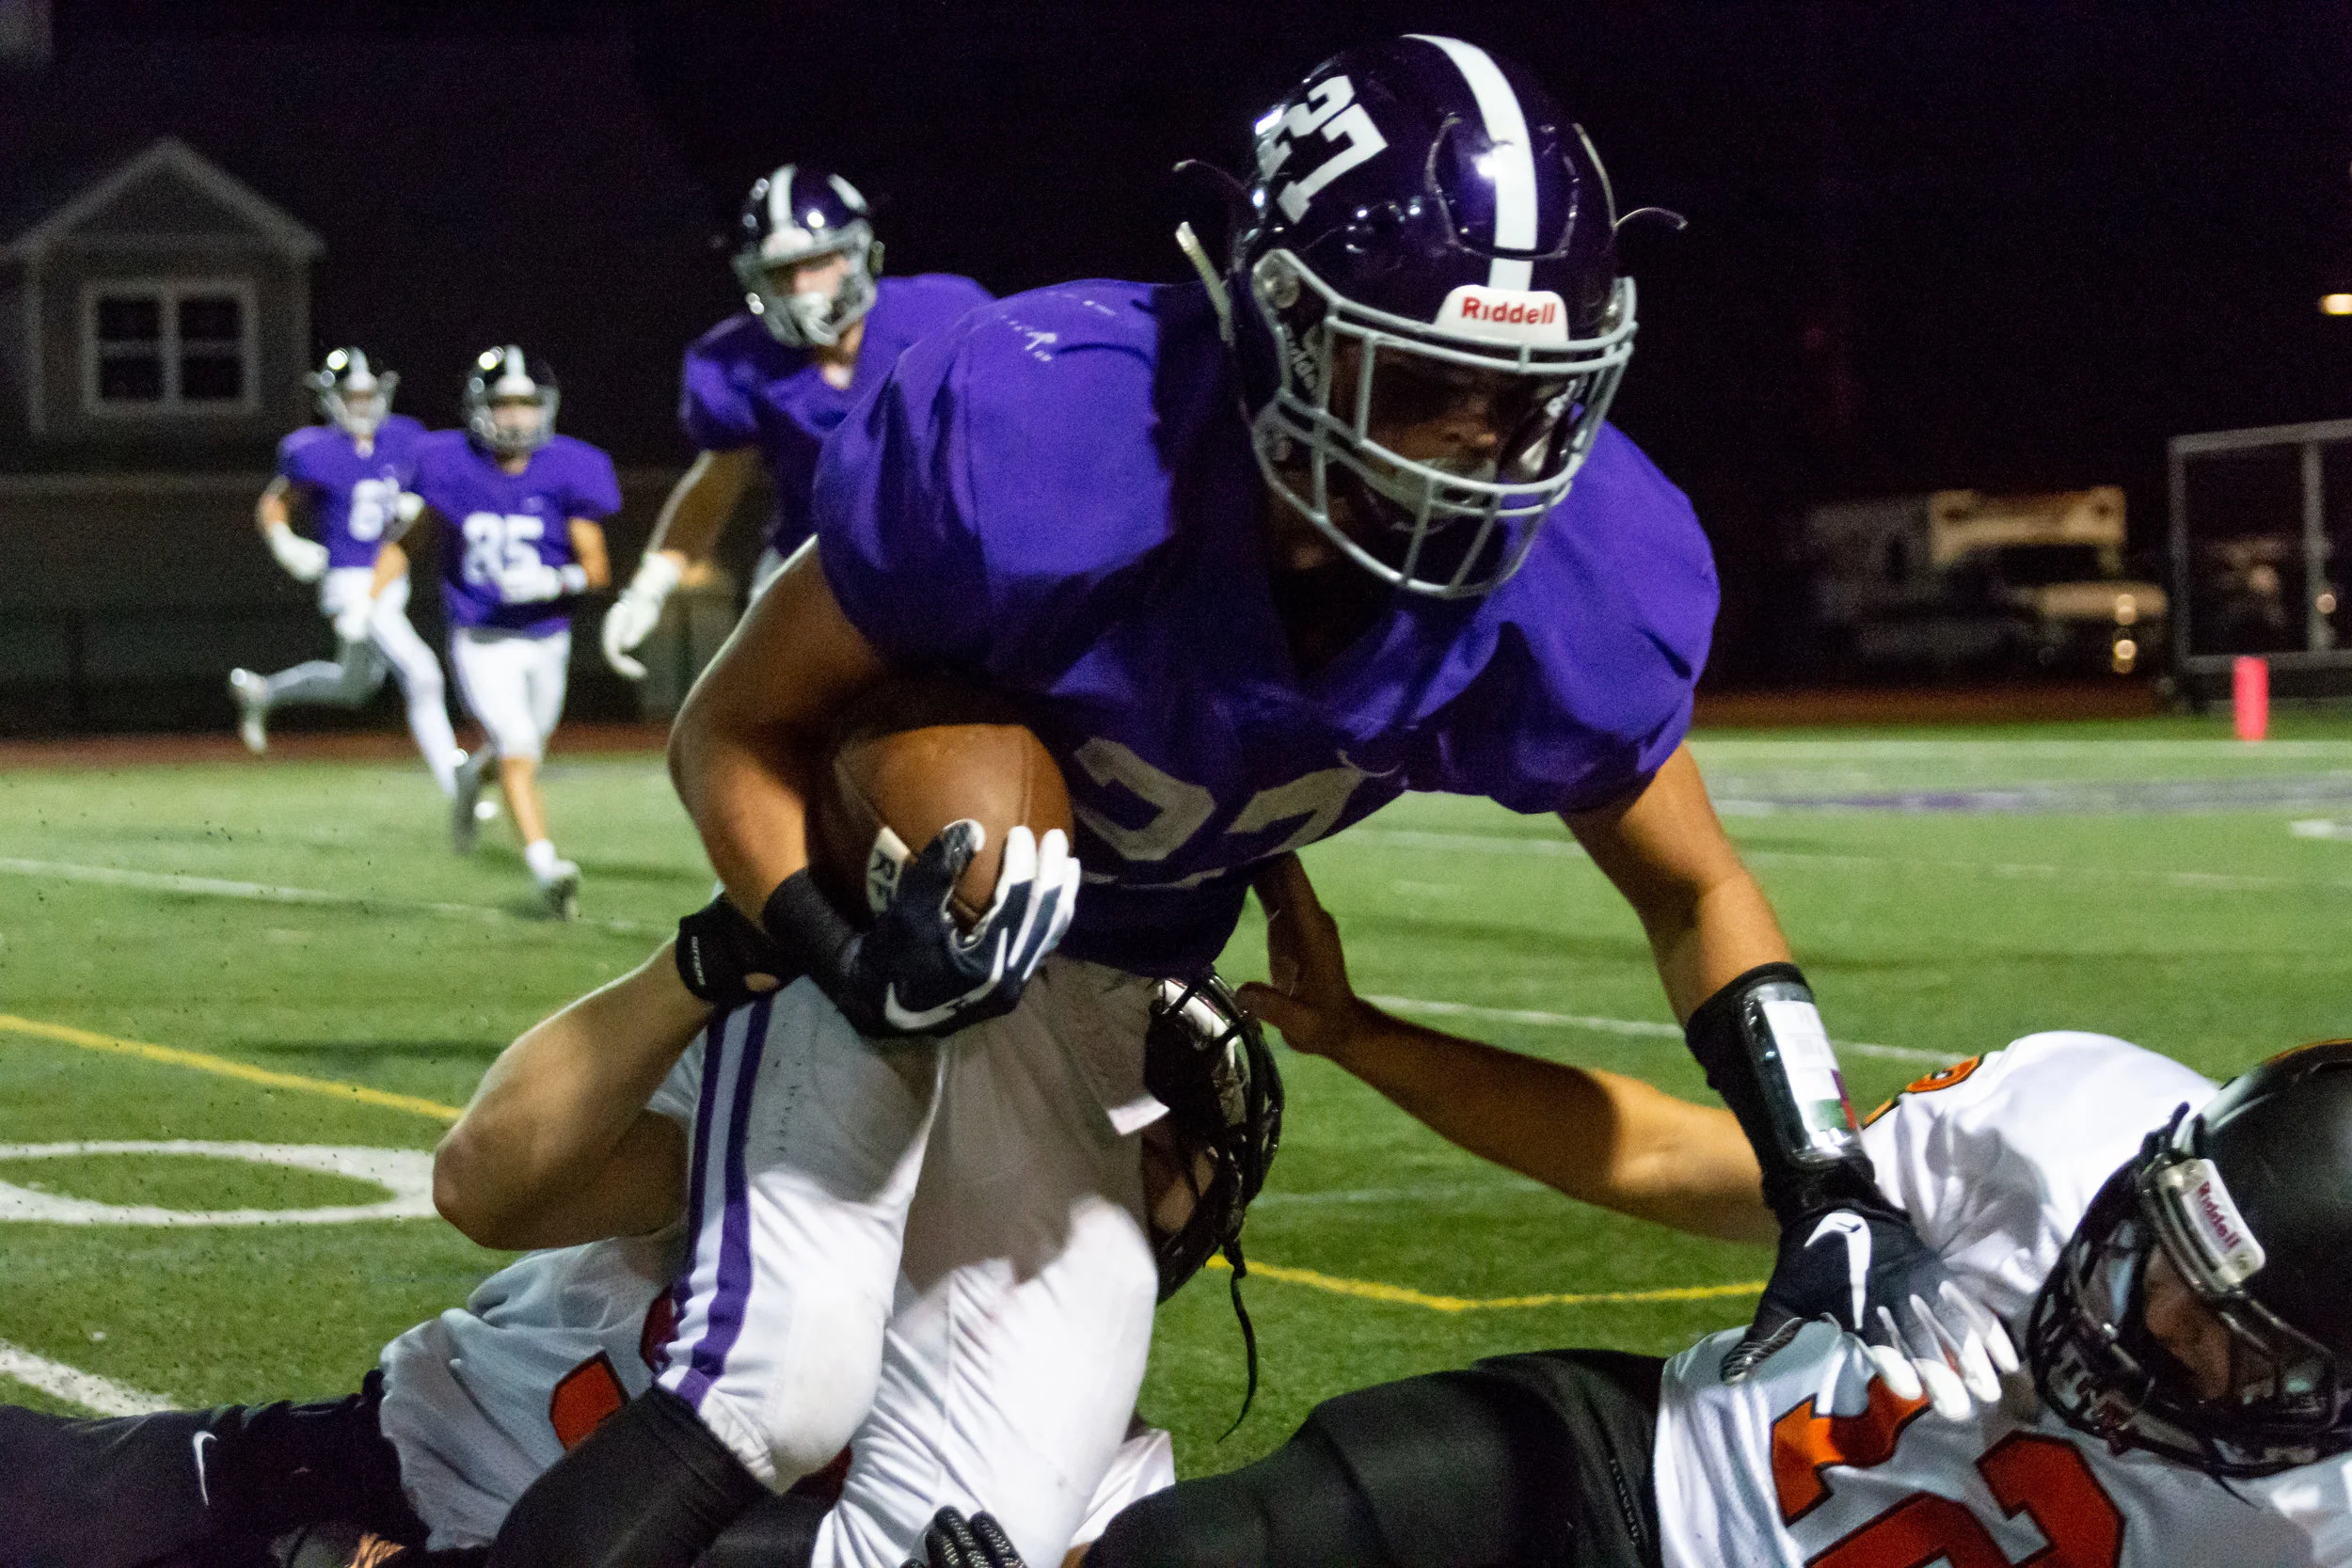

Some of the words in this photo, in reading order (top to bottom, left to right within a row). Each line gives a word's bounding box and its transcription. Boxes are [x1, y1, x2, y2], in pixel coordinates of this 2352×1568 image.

[1255, 74, 1389, 225] 27
[1461, 295, 1555, 324] Riddell
[2198, 1180, 2243, 1249] Riddell
